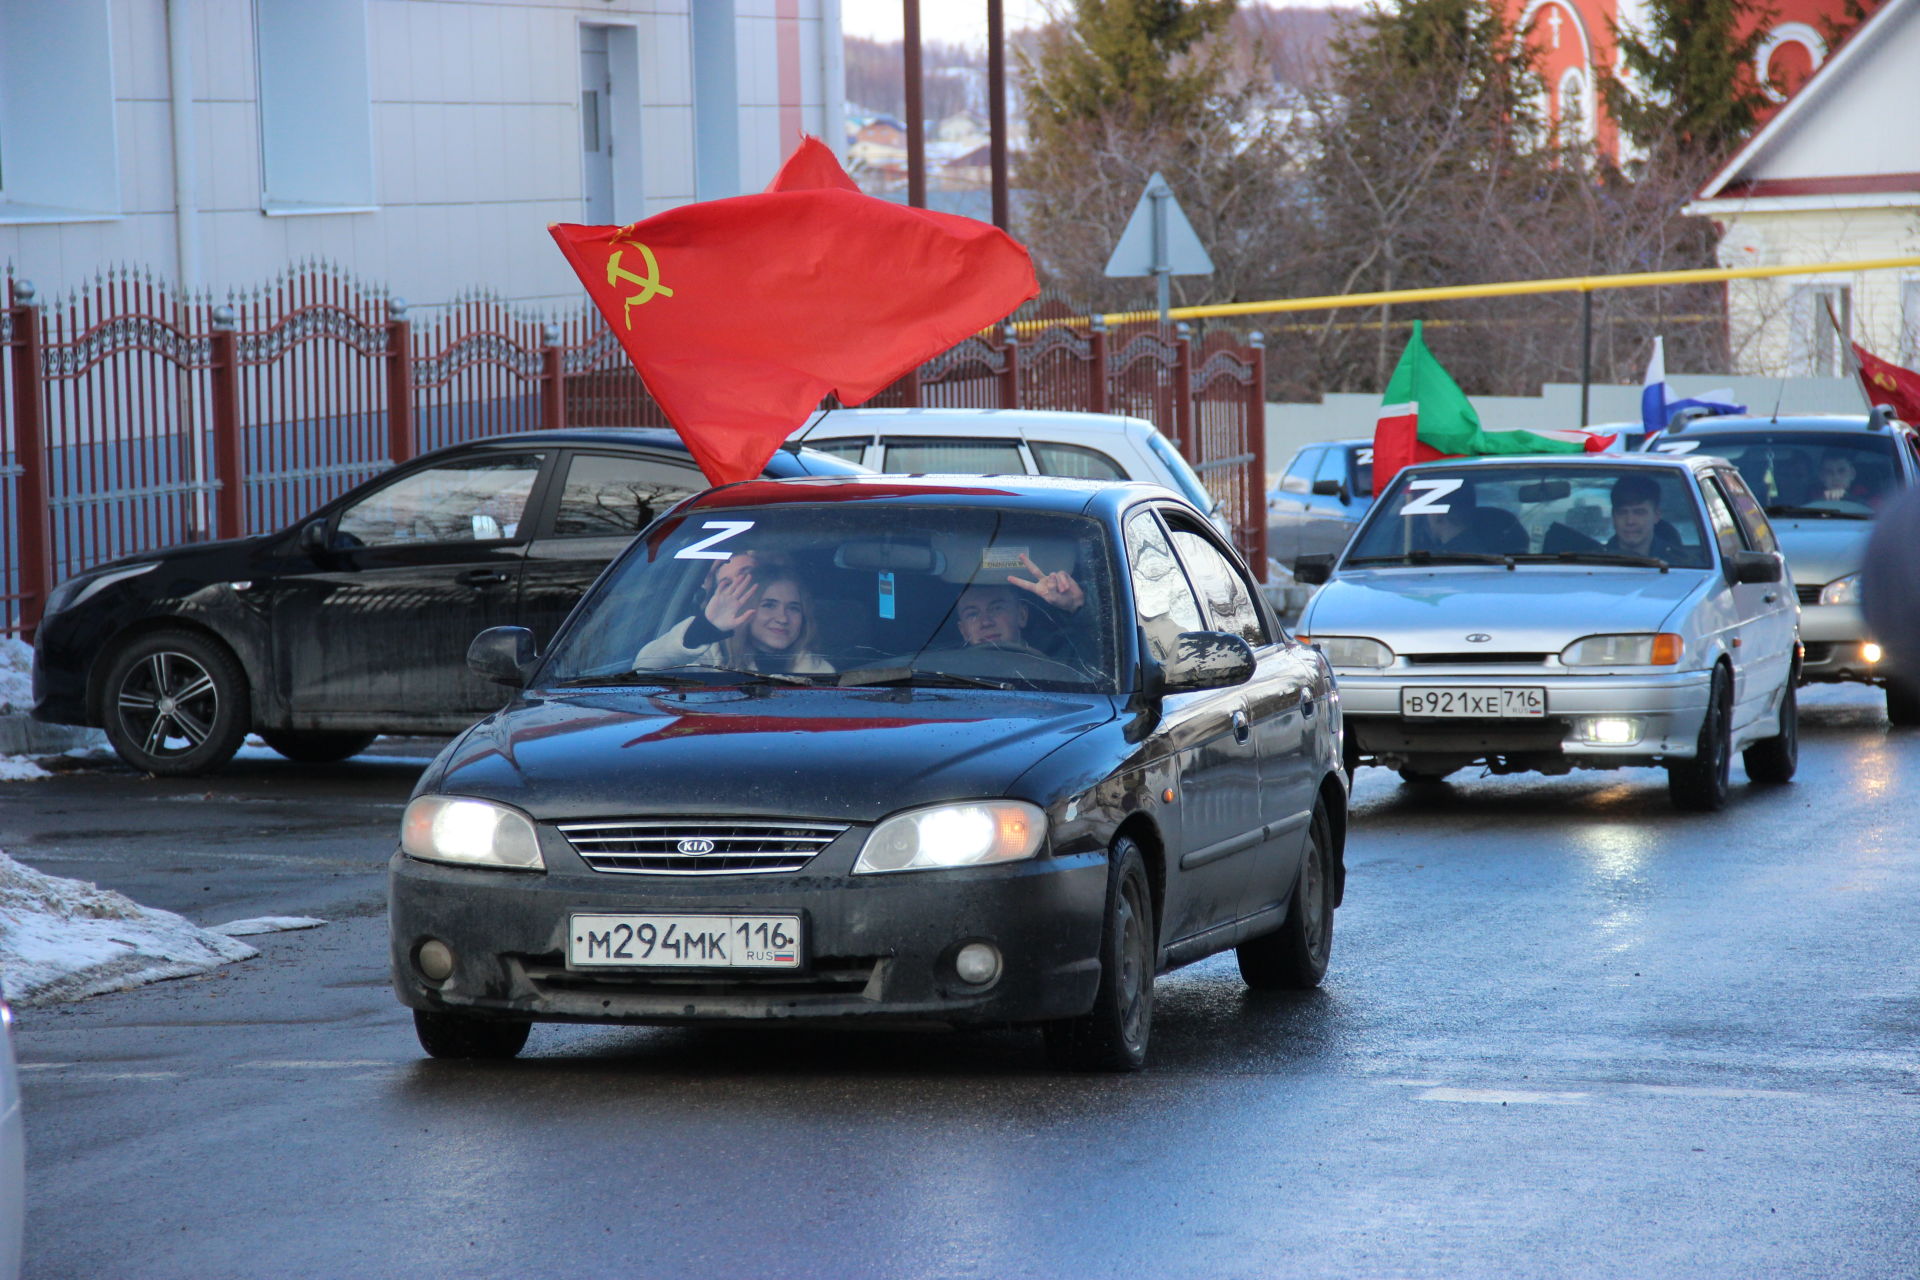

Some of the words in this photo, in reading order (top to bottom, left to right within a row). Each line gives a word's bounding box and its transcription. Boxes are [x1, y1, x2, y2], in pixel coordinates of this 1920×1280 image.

[1400, 479, 1464, 515] Z
[673, 521, 755, 560] Z
[1411, 692, 1498, 713] В921ХЕ
[1503, 691, 1538, 707] 716
[683, 841, 708, 851] KIA
[588, 923, 727, 960] М294МК
[736, 922, 788, 949] 116
[746, 951, 773, 960] RUS
